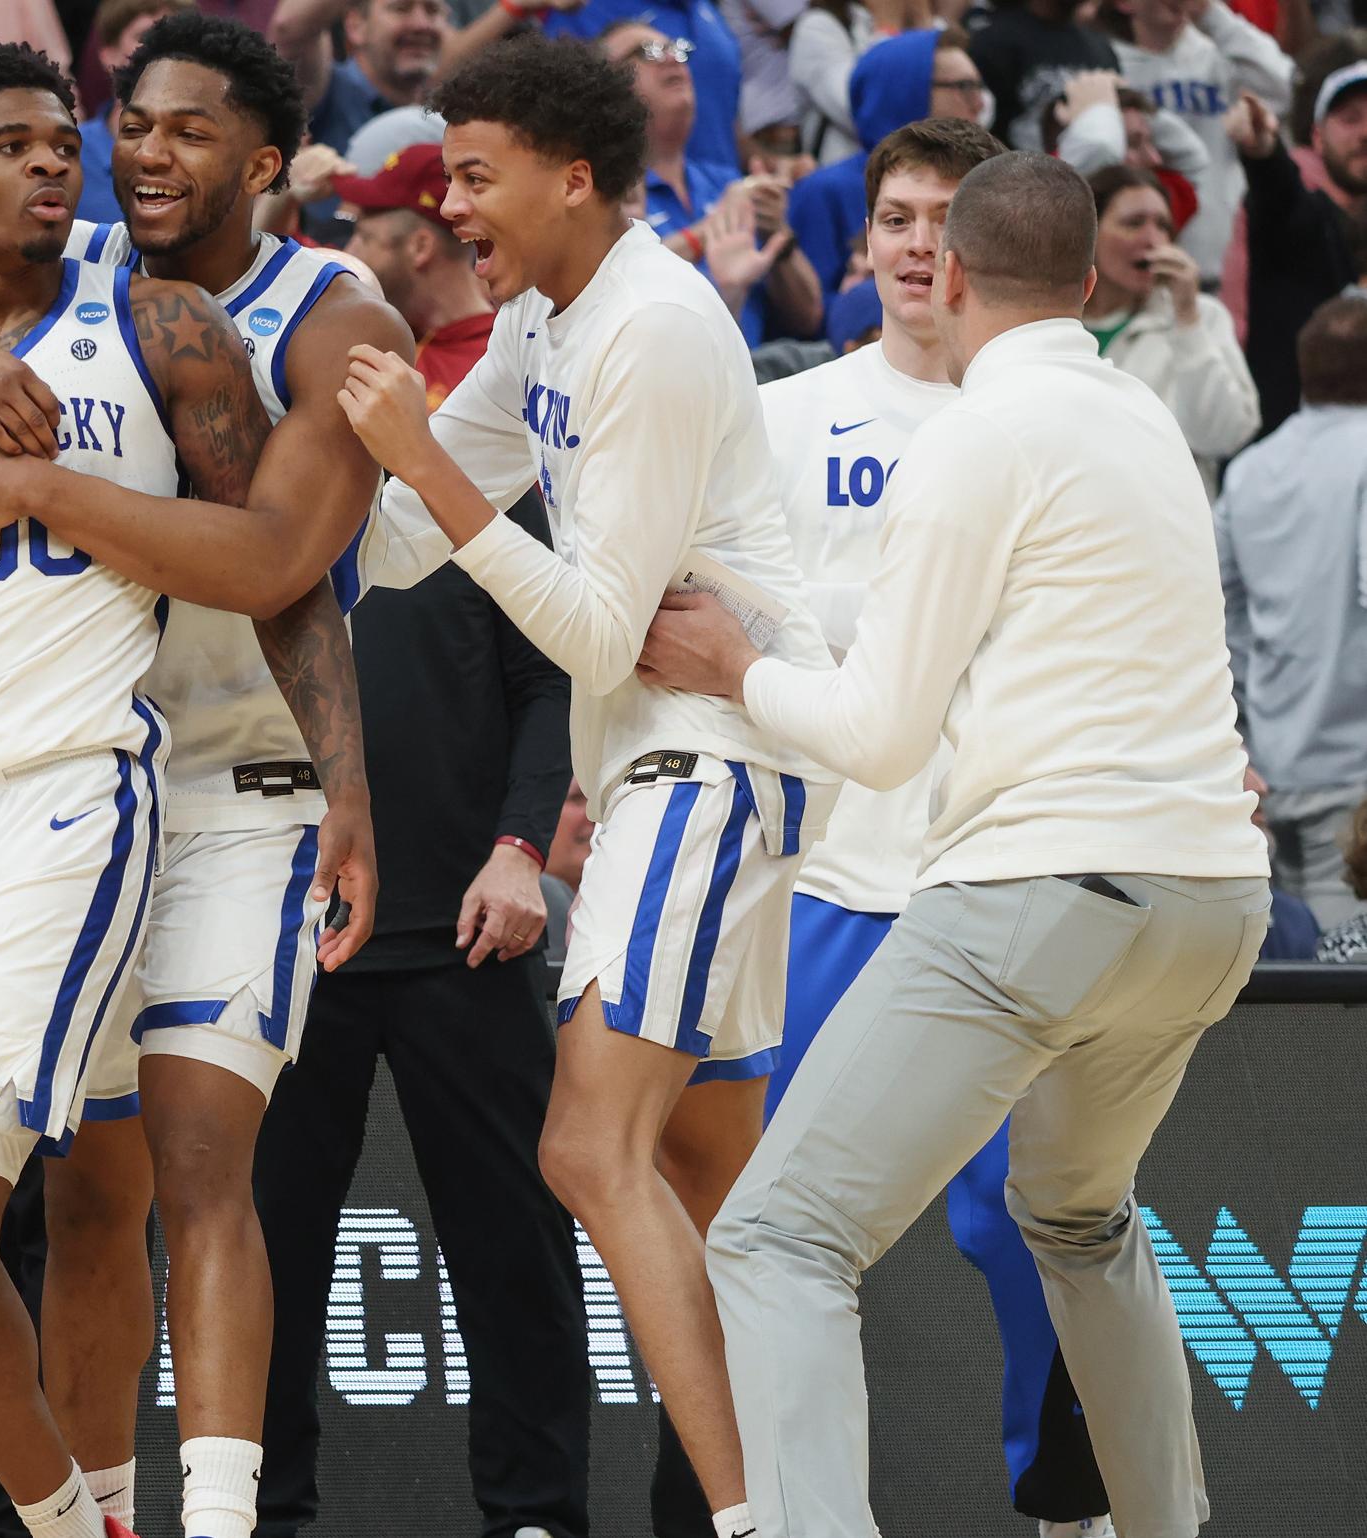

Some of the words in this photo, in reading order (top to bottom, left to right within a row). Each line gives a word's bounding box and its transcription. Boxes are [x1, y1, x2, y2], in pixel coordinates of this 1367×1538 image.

[80, 310, 109, 320] NCAA
[251, 316, 280, 331] NCAA
[73, 341, 95, 359] SEC
[827, 456, 900, 507] LO
[665, 758, 682, 769] 48
[296, 769, 311, 781] 48
